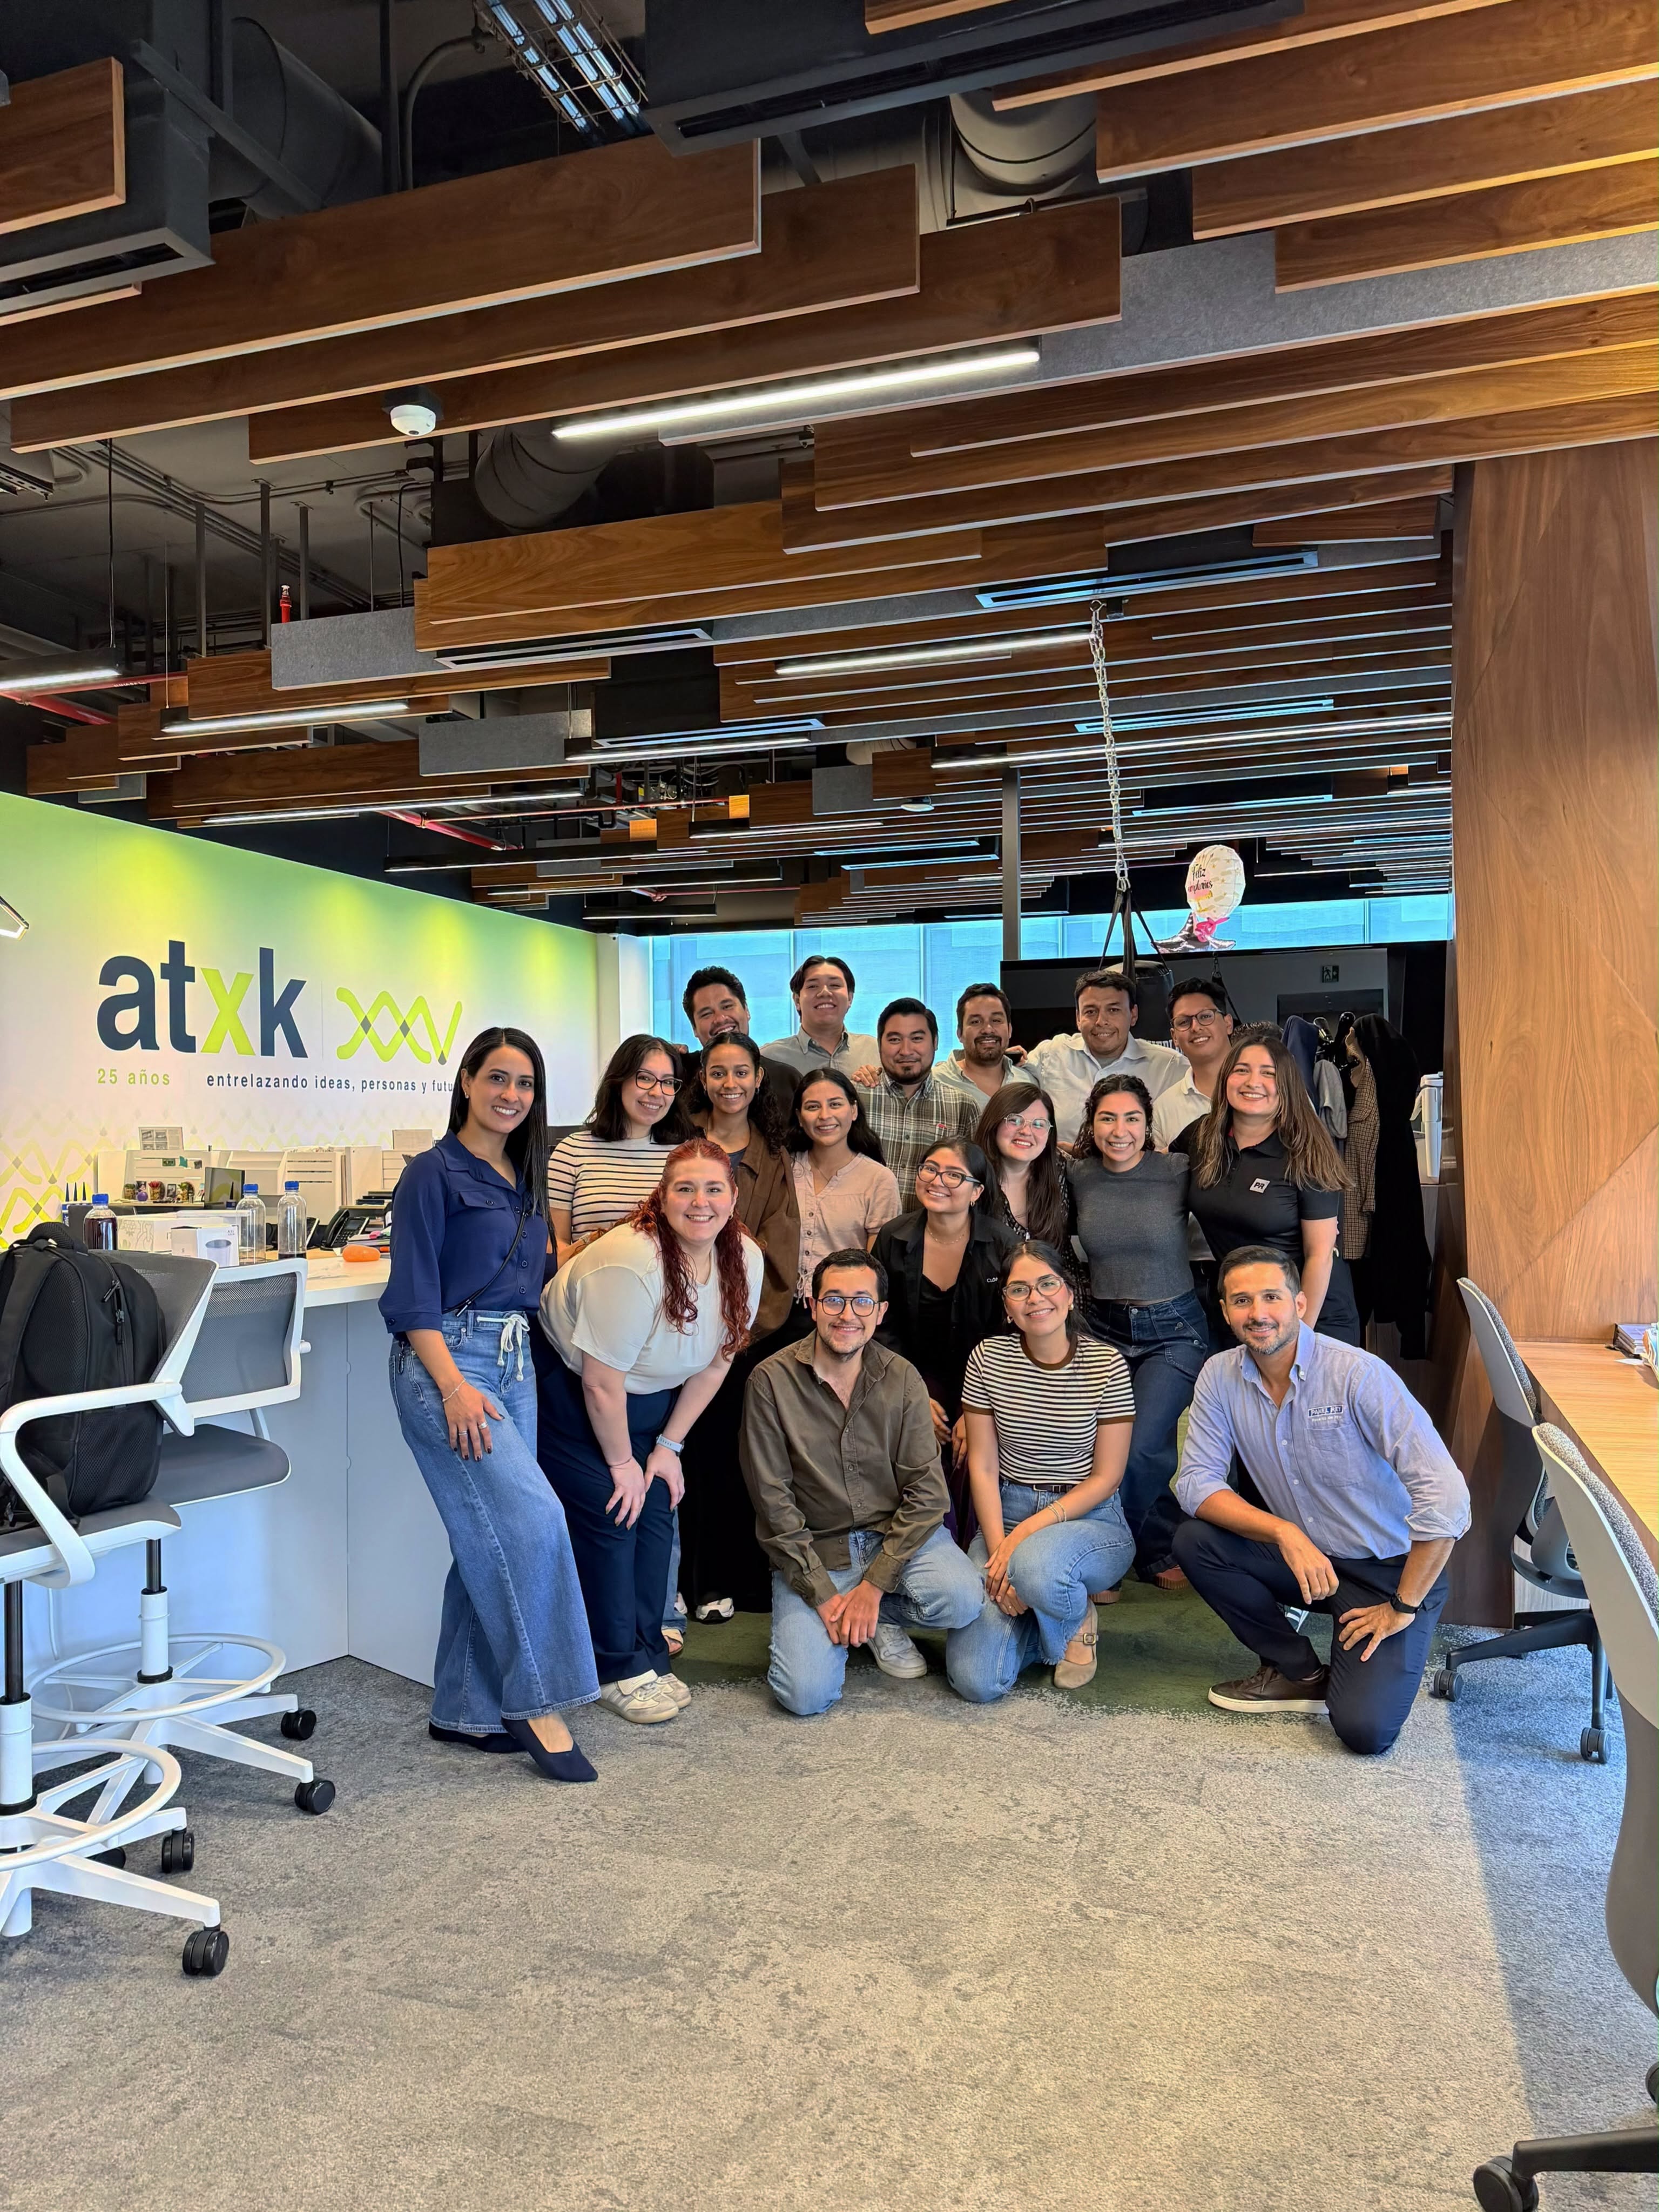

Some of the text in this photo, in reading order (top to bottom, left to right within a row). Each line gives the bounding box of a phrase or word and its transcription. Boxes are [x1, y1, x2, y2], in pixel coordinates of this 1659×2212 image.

[97, 940, 308, 1058] atxk
[97, 1068, 170, 1085] 25 años
[206, 1073, 454, 1094] entrelazando ideas, personas y futu
